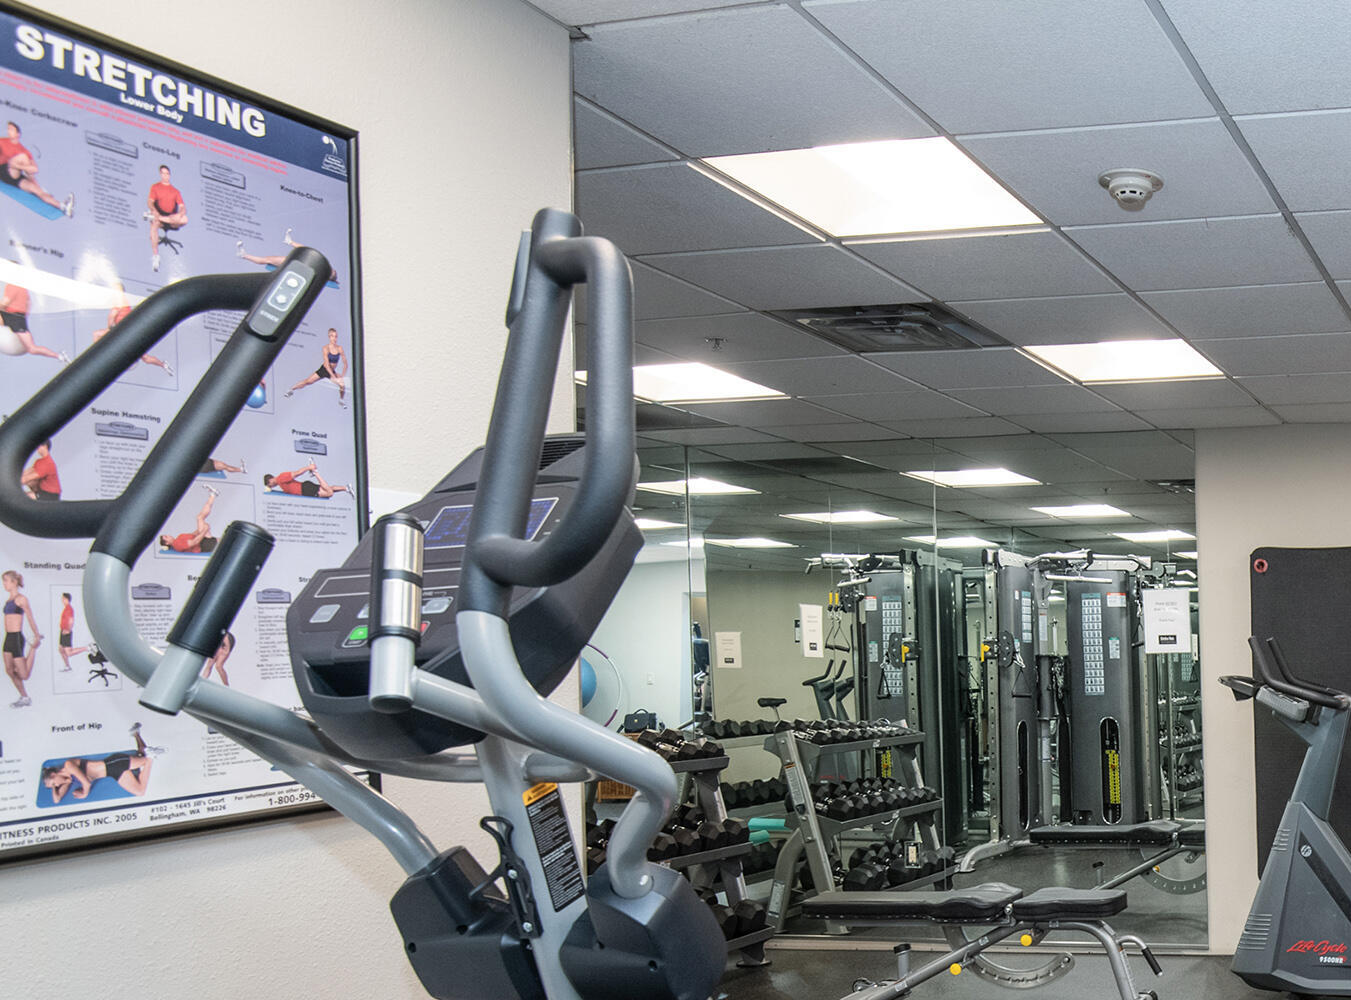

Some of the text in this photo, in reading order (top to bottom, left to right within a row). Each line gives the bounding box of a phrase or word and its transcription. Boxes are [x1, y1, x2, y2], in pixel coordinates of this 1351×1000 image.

[15, 24, 267, 138] STRETCHING
[120, 92, 184, 124] Lower Body
[90, 407, 161, 424] Supine Hamstring
[24, 562, 62, 571] Standing
[51, 722, 103, 733] Front of Hip
[268, 792, 318, 806] 1-800-994
[189, 808, 201, 816] WA
[0, 812, 138, 840] ITNESS PRODUCTS INC. 2005
